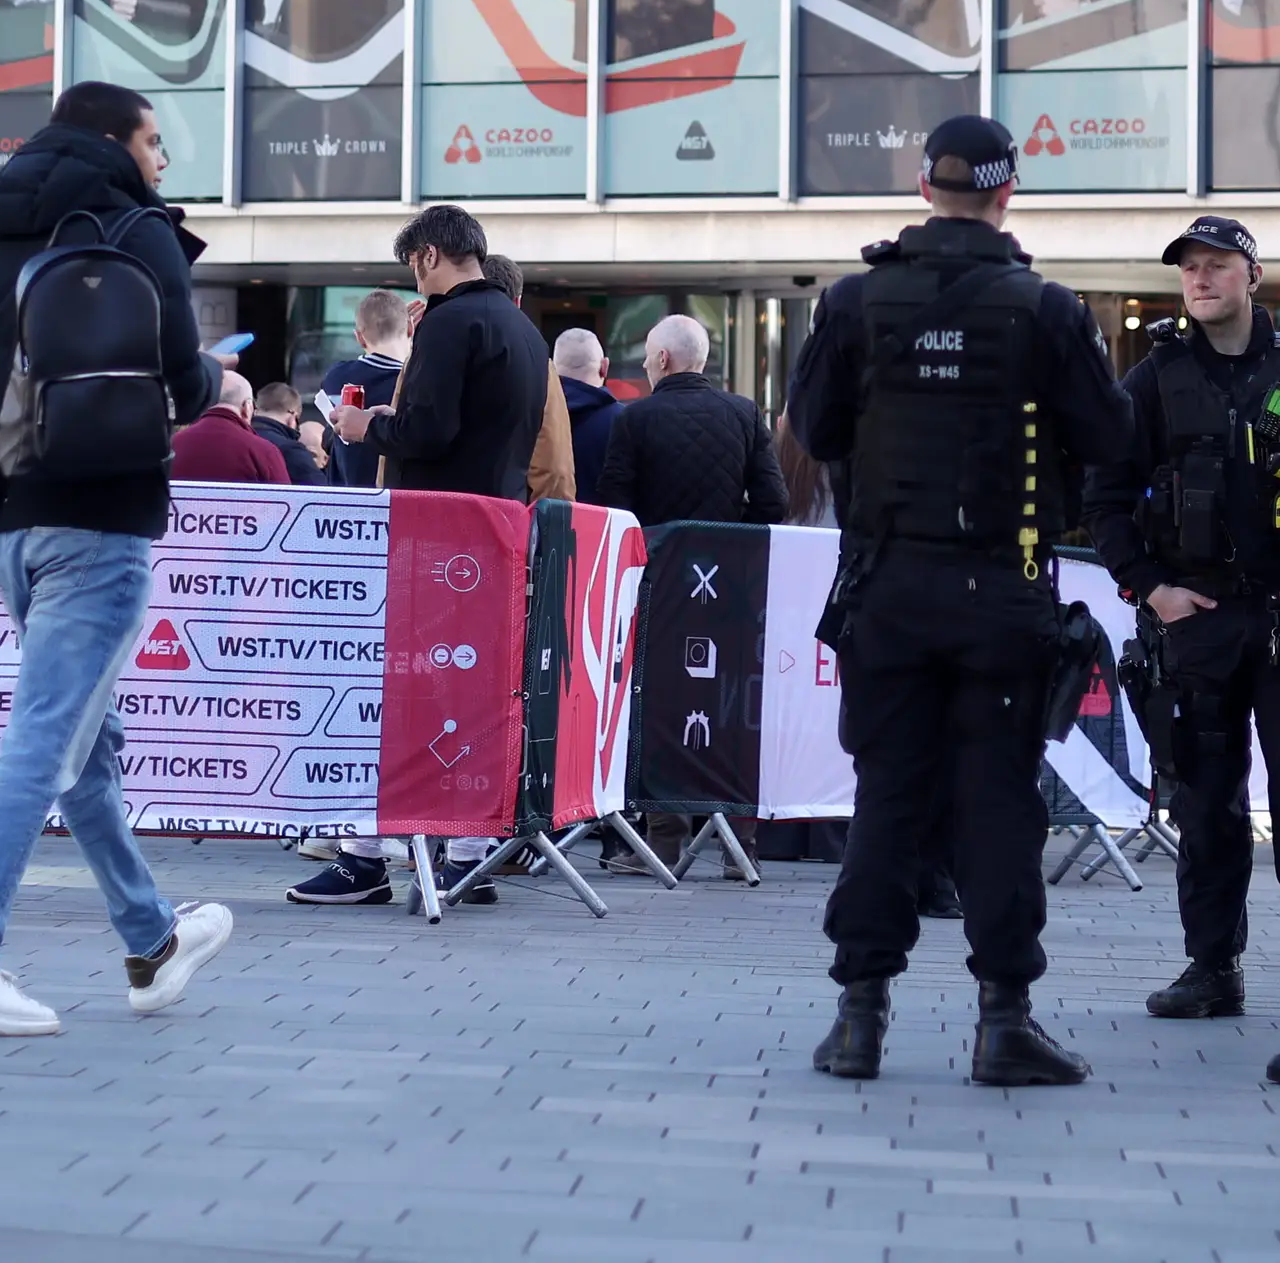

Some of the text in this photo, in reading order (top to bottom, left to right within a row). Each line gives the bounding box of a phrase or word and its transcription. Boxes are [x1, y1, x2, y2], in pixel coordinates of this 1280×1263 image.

[1070, 118, 1146, 135] CAZOO
[485, 128, 554, 144] CAZOO
[827, 133, 871, 146] TRIPLE
[269, 140, 386, 155] TRIPLE CROWN
[168, 574, 367, 601] WST.TV/TICKETS
[143, 640, 182, 655] WST
